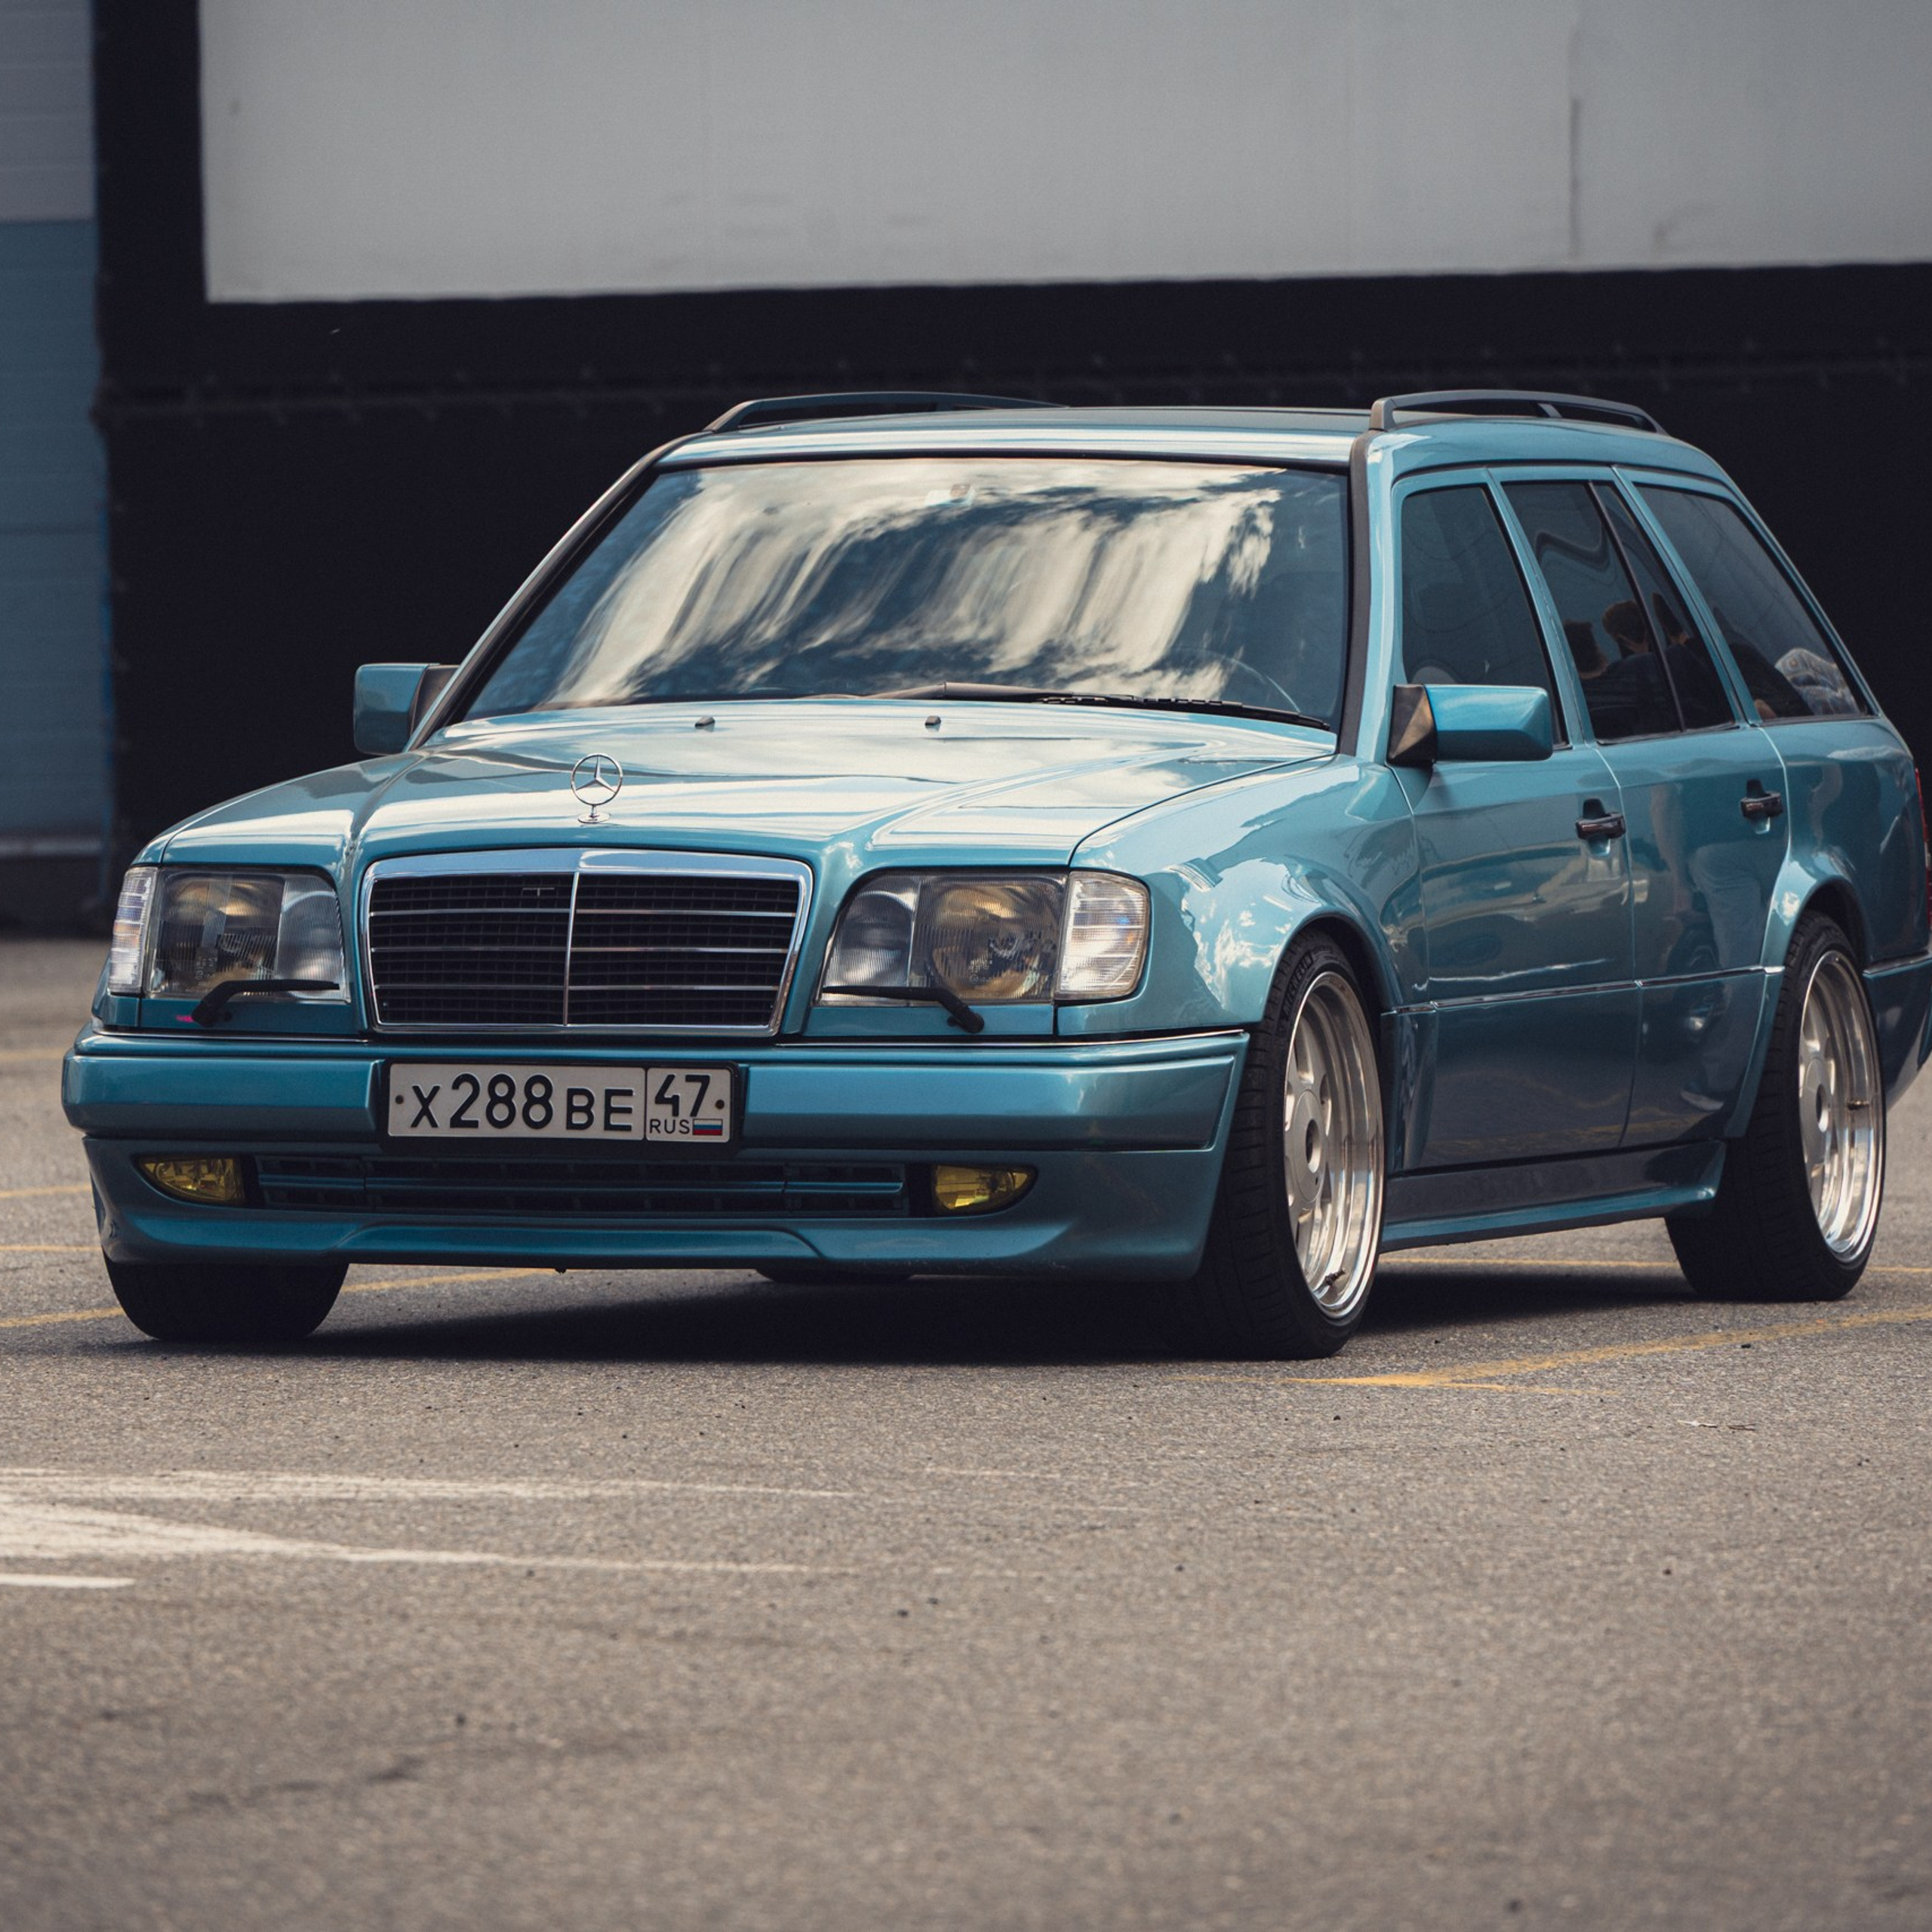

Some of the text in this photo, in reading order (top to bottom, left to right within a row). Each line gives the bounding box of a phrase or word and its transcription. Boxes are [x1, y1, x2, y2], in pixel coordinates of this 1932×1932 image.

[1284, 952, 1314, 1017] MICHELIN
[654, 1074, 711, 1117] 47
[649, 1118, 691, 1134] RUS
